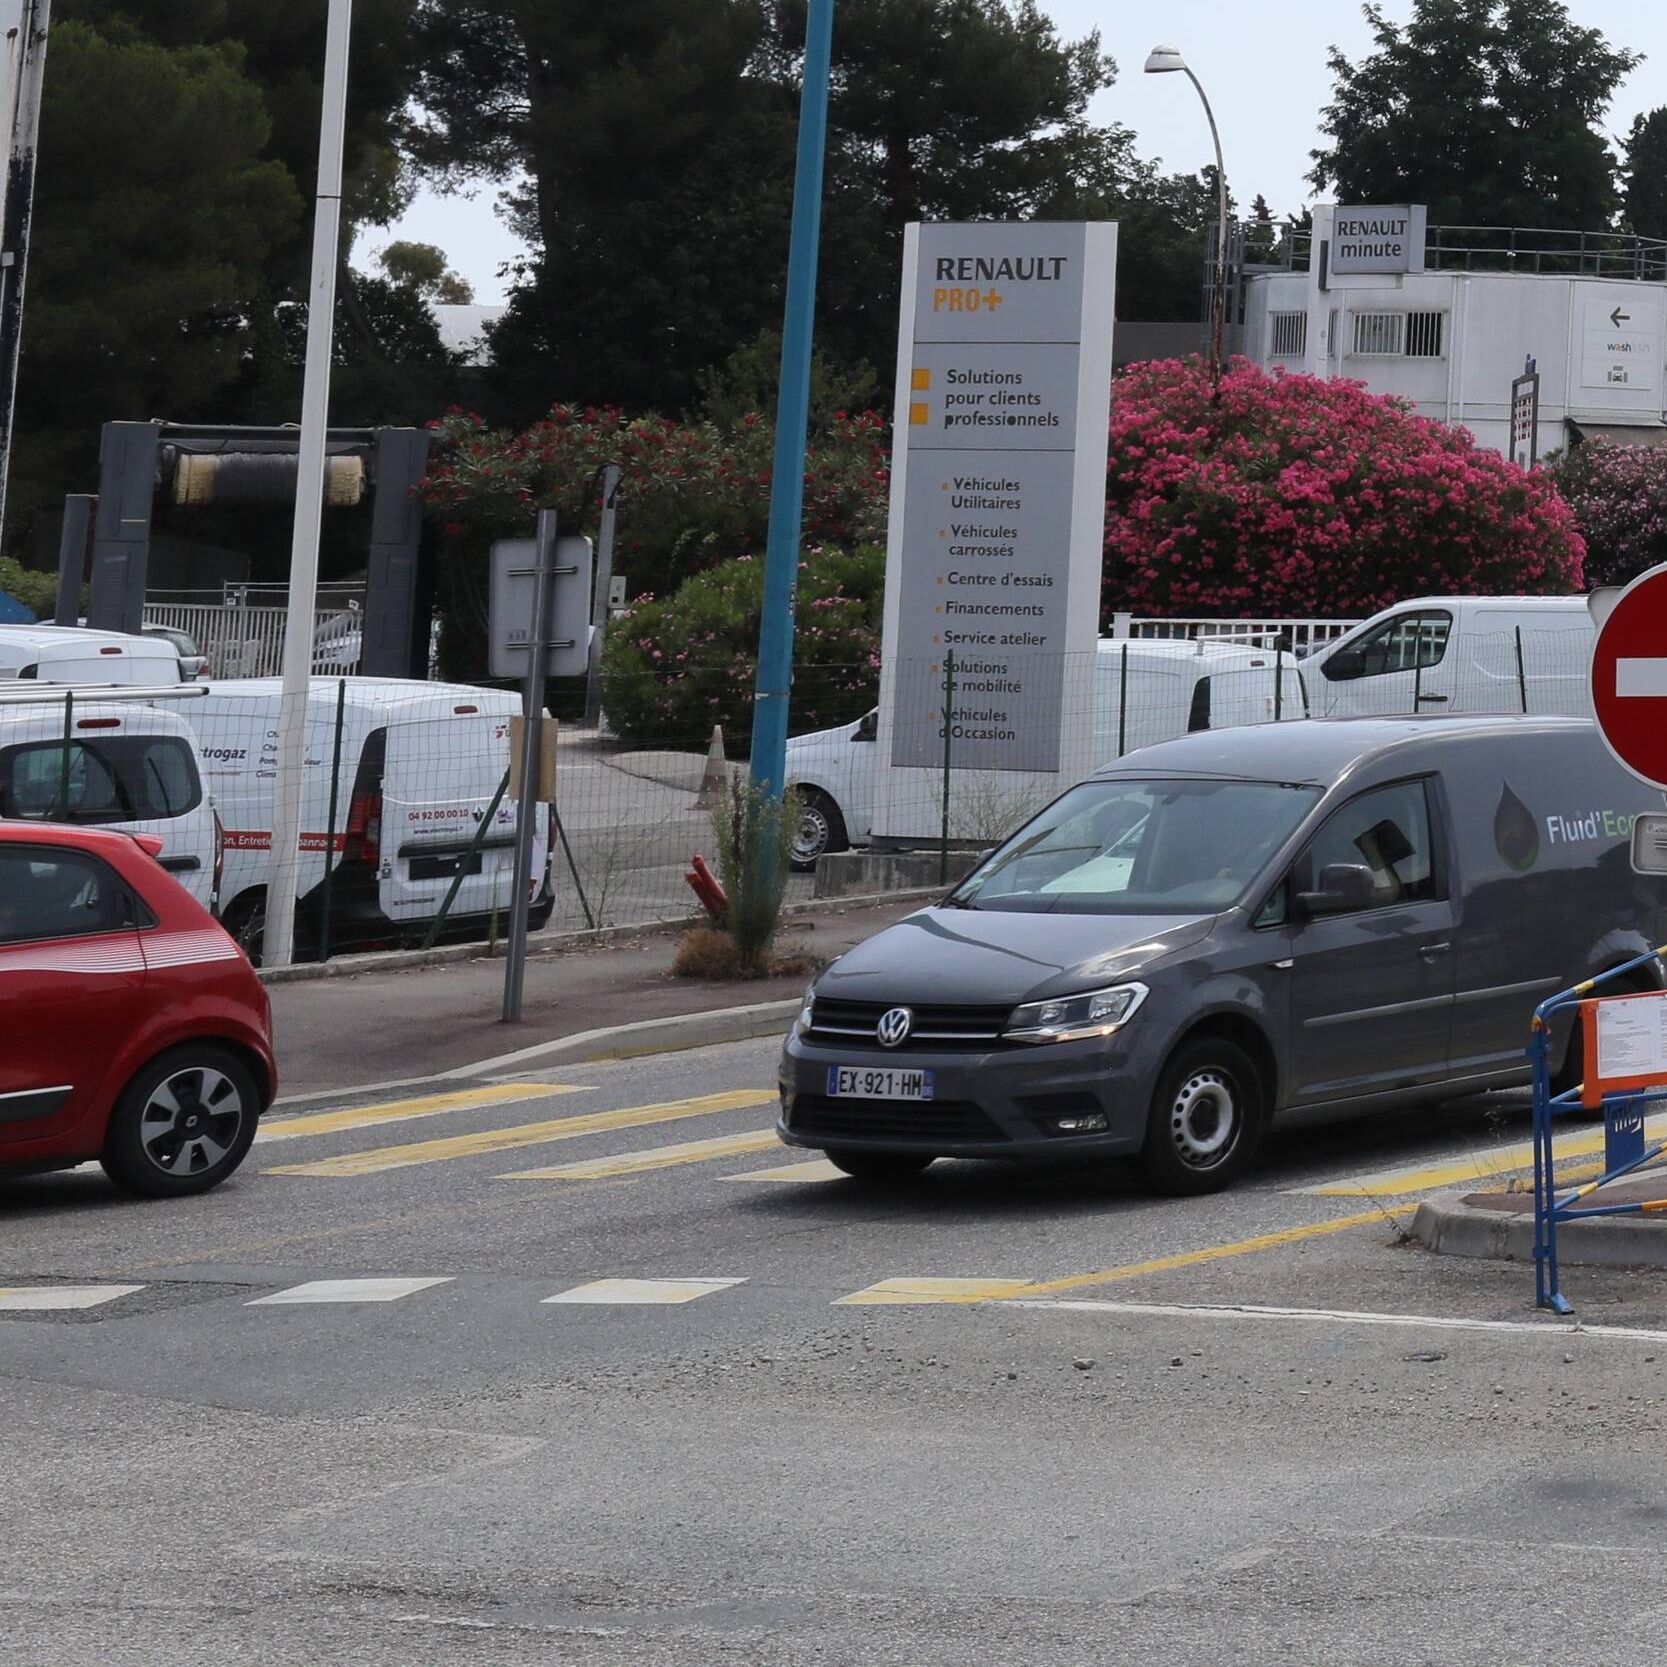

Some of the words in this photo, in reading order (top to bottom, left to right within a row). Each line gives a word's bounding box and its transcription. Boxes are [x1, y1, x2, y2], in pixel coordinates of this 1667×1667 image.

[1338, 220, 1407, 236] RENAULT
[1341, 239, 1401, 257] minute
[936, 257, 1067, 281] RENAULT
[933, 288, 1003, 312] PRO+
[946, 369, 1023, 385] Solutions
[945, 392, 984, 409] pour
[989, 390, 1041, 406] clients
[944, 411, 1060, 429] professionnels
[953, 477, 1021, 492] Véhicules
[951, 495, 1021, 510] Utilitaires
[951, 524, 1018, 539] Véhicules
[949, 543, 1014, 557] carrossés
[947, 572, 997, 585] Centre
[1001, 573, 1053, 587] d'essais
[945, 601, 1044, 616] Financements
[944, 630, 996, 645] Service
[1000, 633, 1047, 646] atelier
[942, 660, 1008, 674] Solutions
[962, 679, 1022, 693] mobilité
[408, 812, 420, 821] 04
[422, 811, 432, 820] 92
[434, 811, 445, 819] 00
[447, 810, 457, 818] 00
[459, 809, 469, 817] 10
[839, 1071, 923, 1096] EX-921-HM
